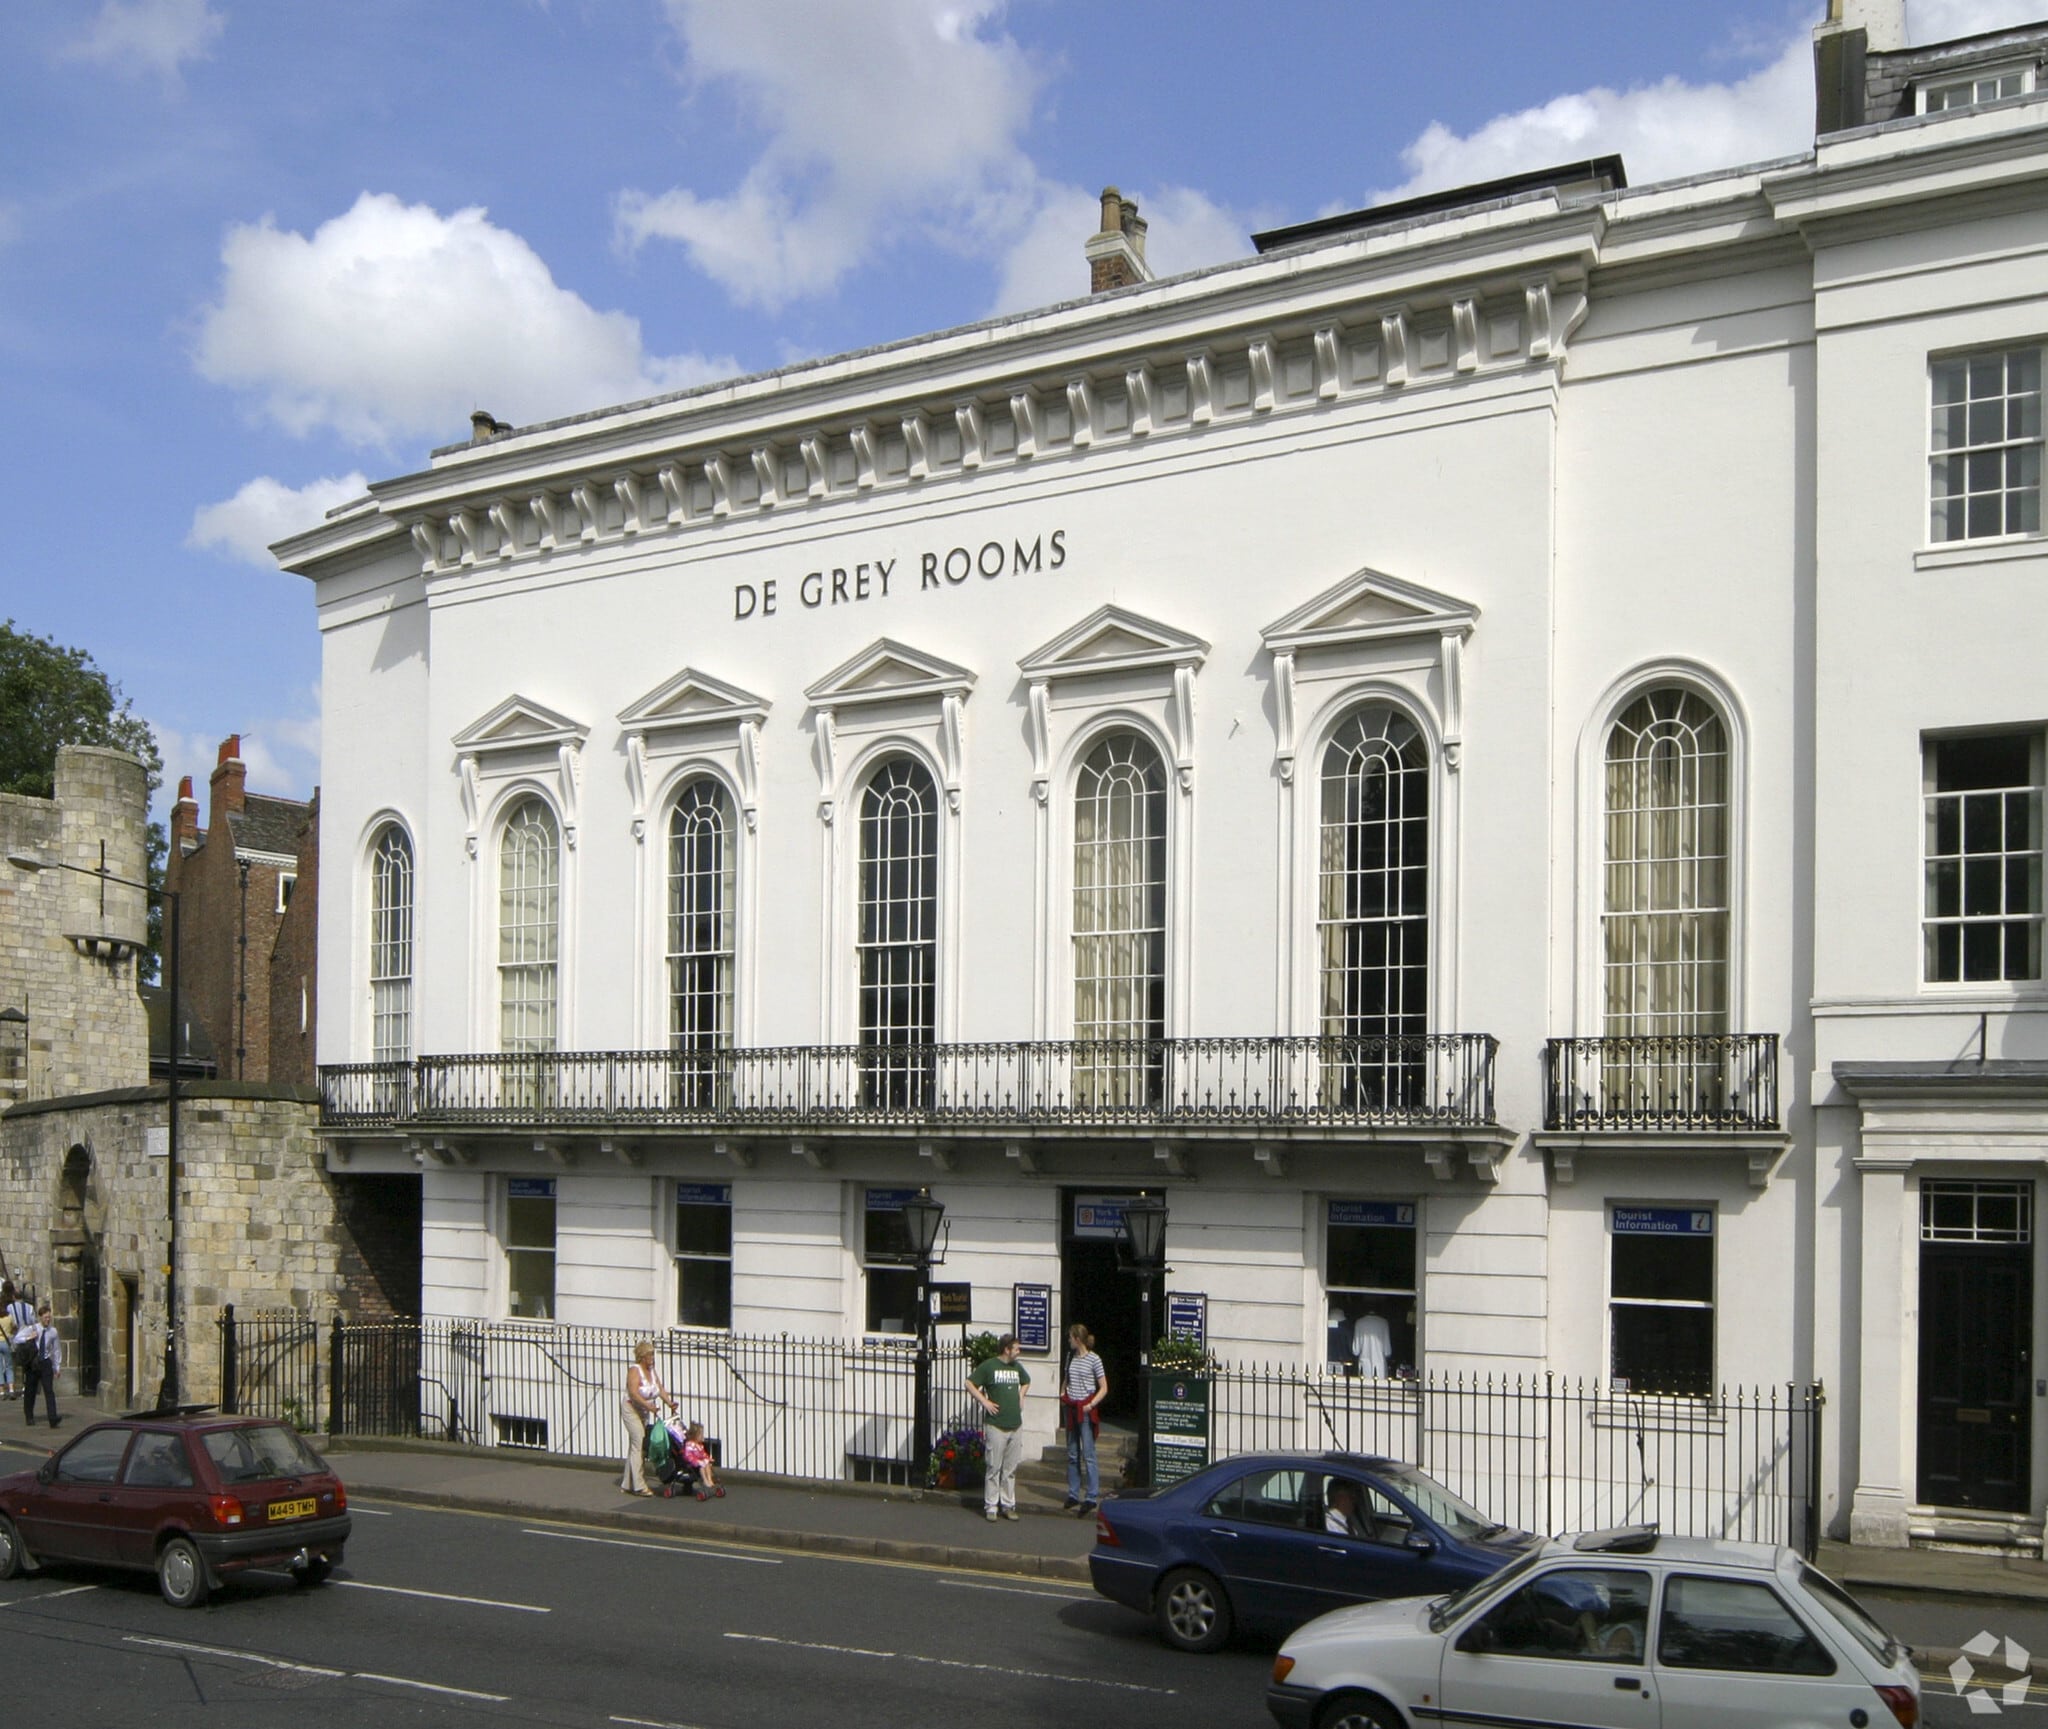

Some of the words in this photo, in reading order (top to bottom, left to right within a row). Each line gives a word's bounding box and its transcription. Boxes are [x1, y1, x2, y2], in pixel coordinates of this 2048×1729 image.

[734, 580, 777, 620] DE
[800, 559, 897, 608] GREY
[920, 530, 1066, 591] ROOMS
[1330, 1202, 1362, 1213] Tourist
[1330, 1212, 1385, 1223] Information
[1615, 1210, 1652, 1221] Tourist
[1615, 1220, 1678, 1231] Information
[269, 1503, 295, 1517] M449
[297, 1500, 315, 1513] TMH
